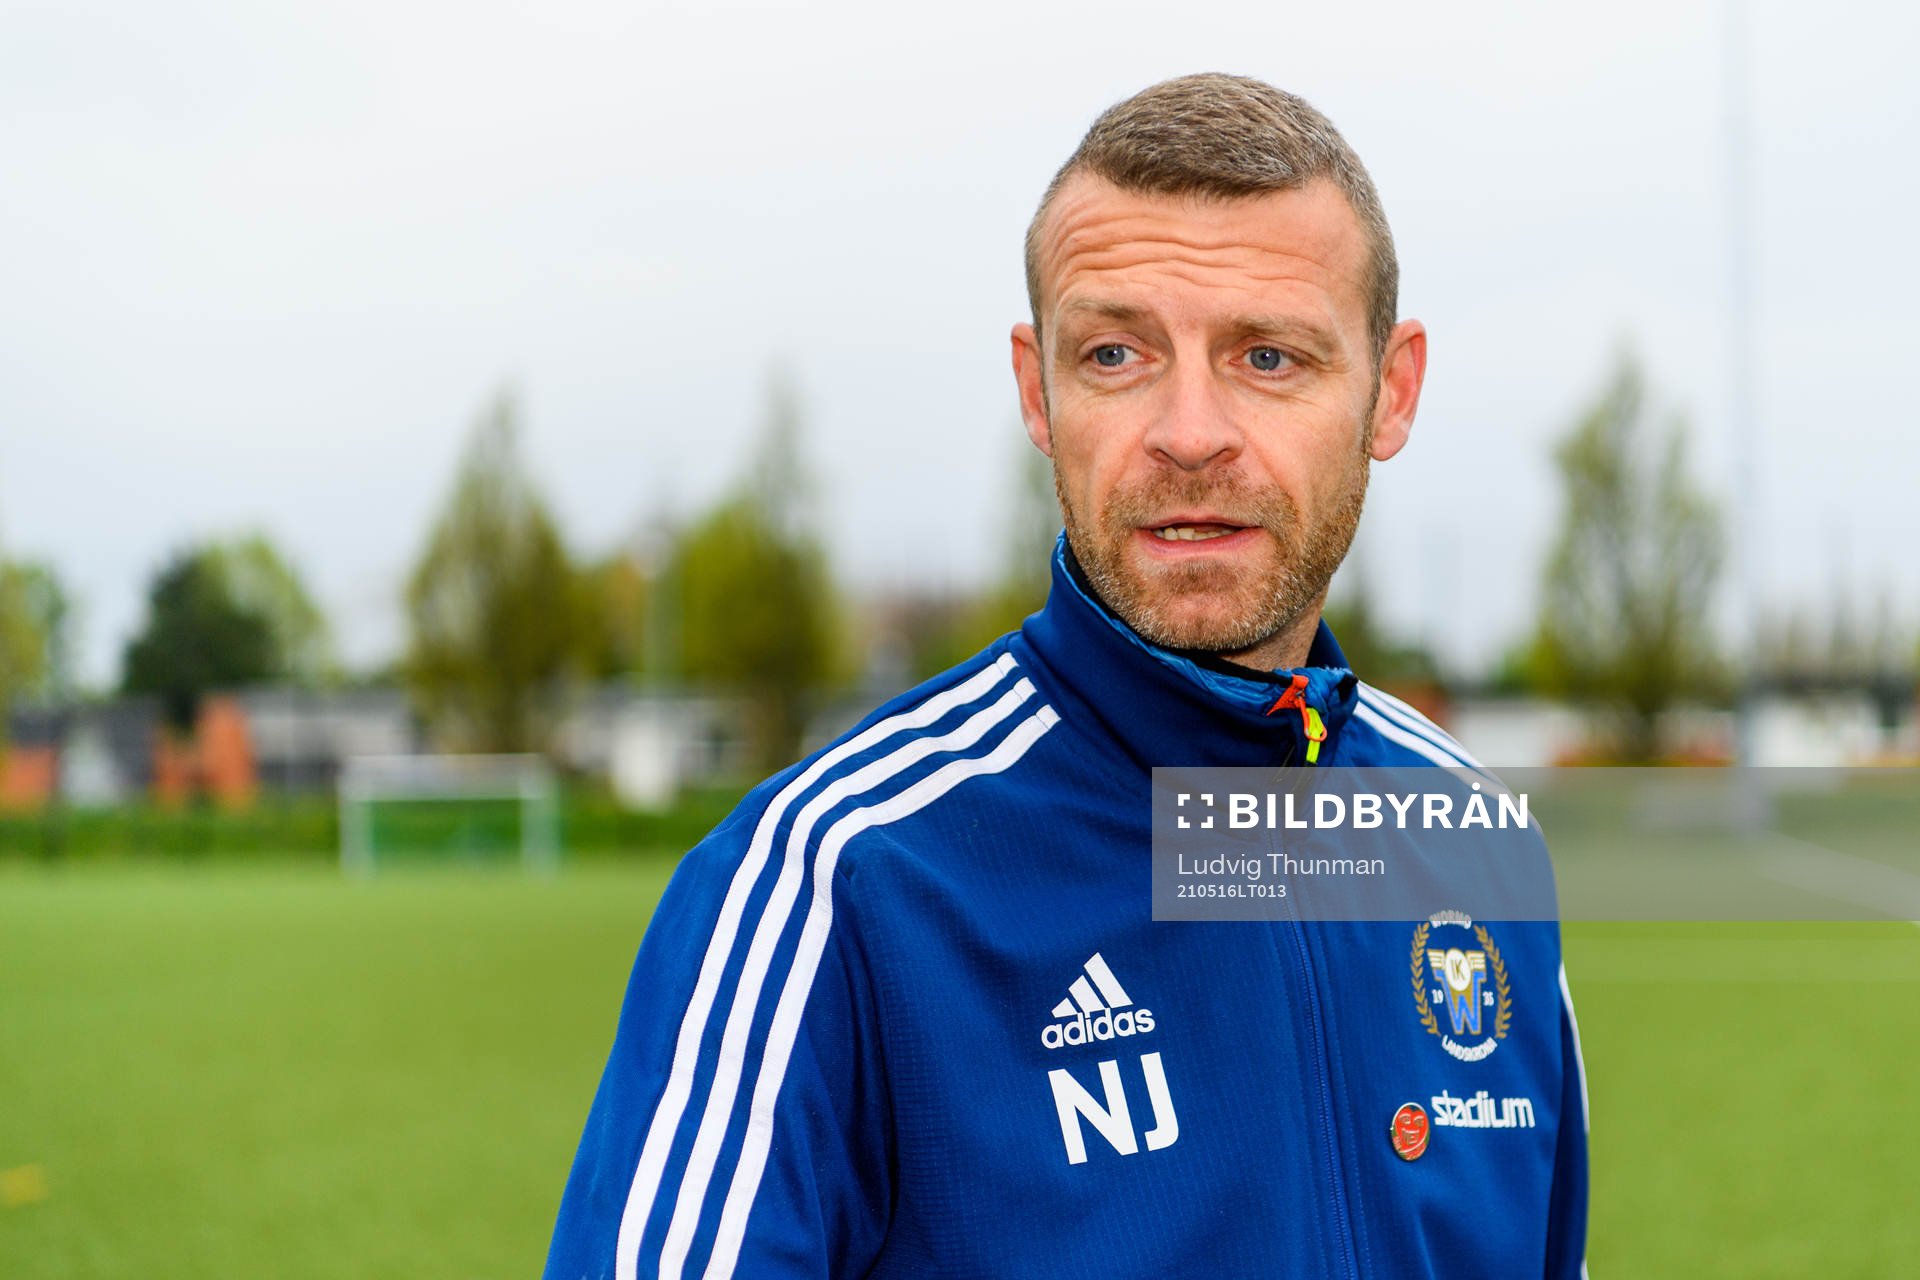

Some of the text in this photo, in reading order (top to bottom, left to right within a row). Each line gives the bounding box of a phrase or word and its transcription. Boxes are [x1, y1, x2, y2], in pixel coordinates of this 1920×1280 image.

[1041, 1007, 1156, 1049] adidas
[1047, 1051, 1179, 1165] NJ
[1431, 1089, 1536, 1128] stadium
